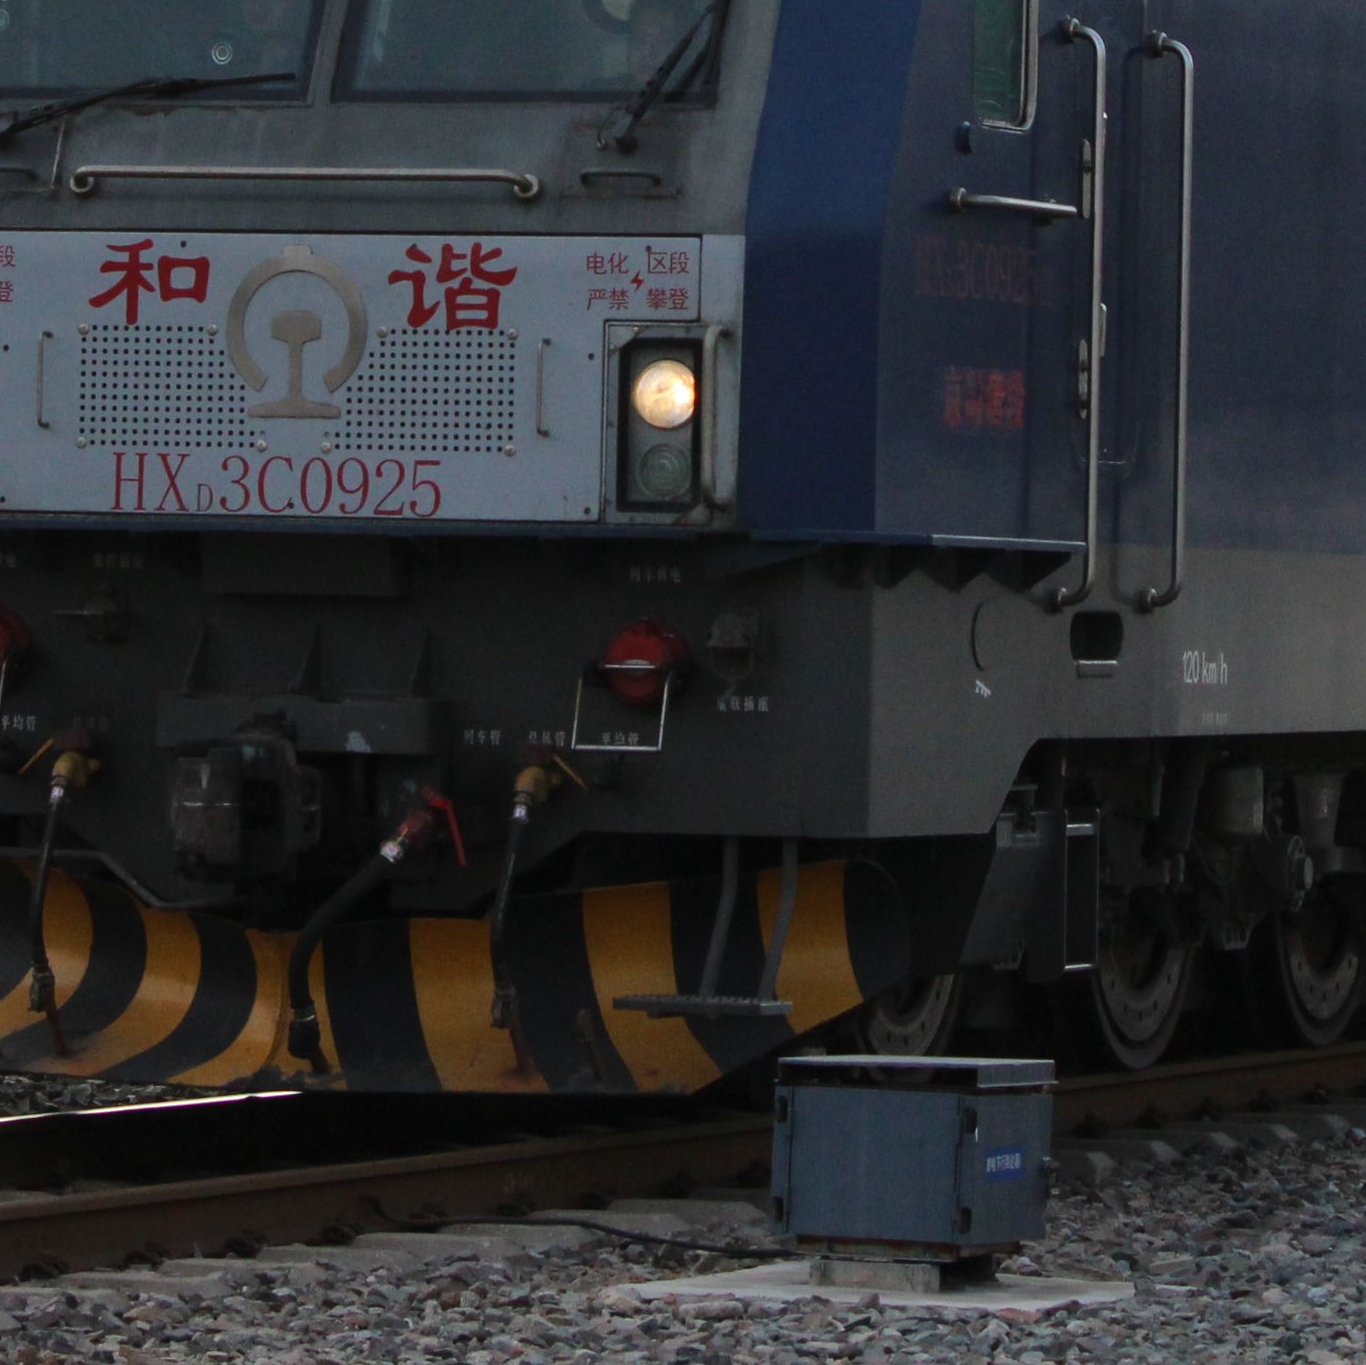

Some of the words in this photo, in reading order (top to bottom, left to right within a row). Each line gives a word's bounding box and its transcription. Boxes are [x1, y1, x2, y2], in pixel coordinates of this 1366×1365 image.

[89, 239, 211, 325] 和
[388, 242, 518, 330] 谐
[586, 251, 690, 274] 电化区段
[914, 235, 1037, 304] 3C0925
[586, 288, 689, 310] 严禁攀登
[111, 452, 442, 517] HXD3C0925
[1182, 650, 1200, 684] 120
